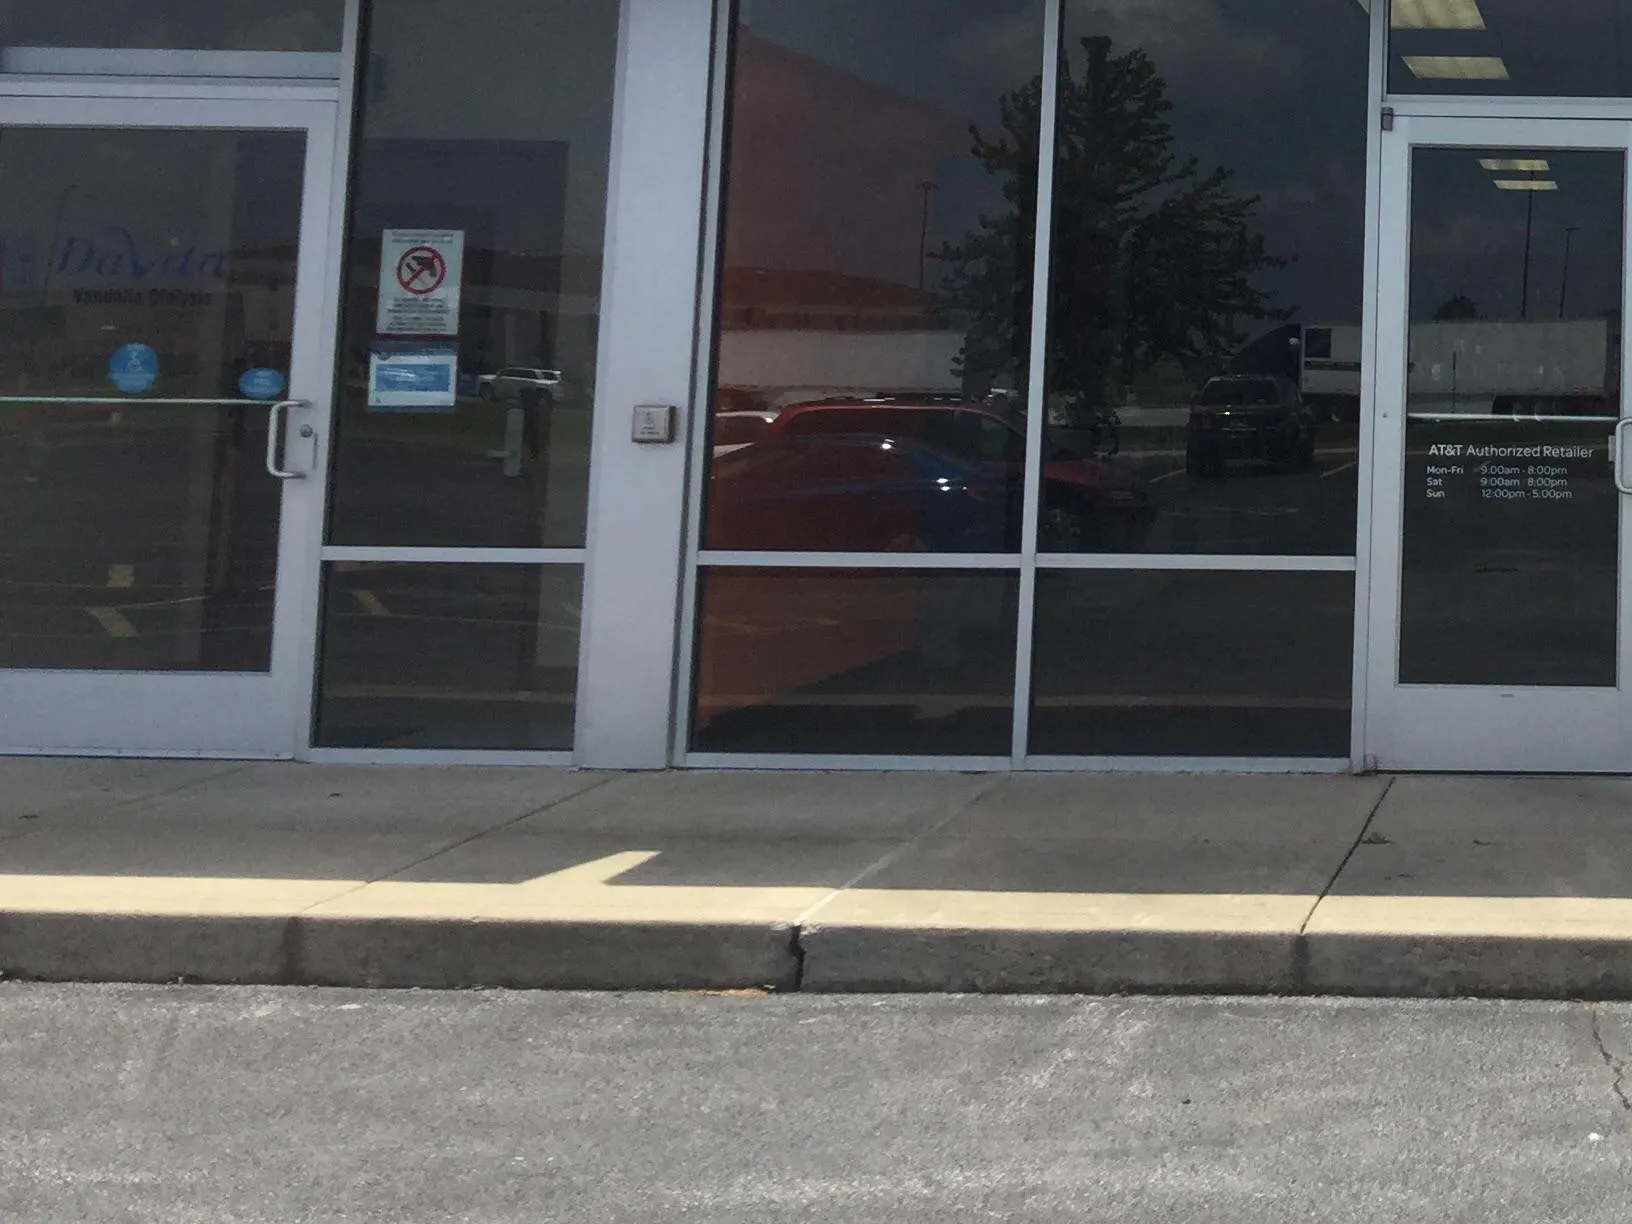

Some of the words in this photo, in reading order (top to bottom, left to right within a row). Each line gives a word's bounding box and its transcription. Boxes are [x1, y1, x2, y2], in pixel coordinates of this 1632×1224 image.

[1428, 444, 1464, 456] AT&T
[1466, 444, 1541, 458] Authorized
[1543, 445, 1594, 458] Retailer
[1426, 465, 1464, 475] Mon-Fri
[1480, 465, 1520, 475] 9:00am
[1527, 465, 1568, 477] 8:00pm
[1426, 477, 1443, 487] Sat
[1480, 477, 1520, 487] 9:00am
[1527, 477, 1568, 489] 8:00pm
[1426, 489, 1445, 498] Sun
[1481, 489, 1525, 500] 12:00pm
[1532, 489, 1573, 500] 5:00pm
